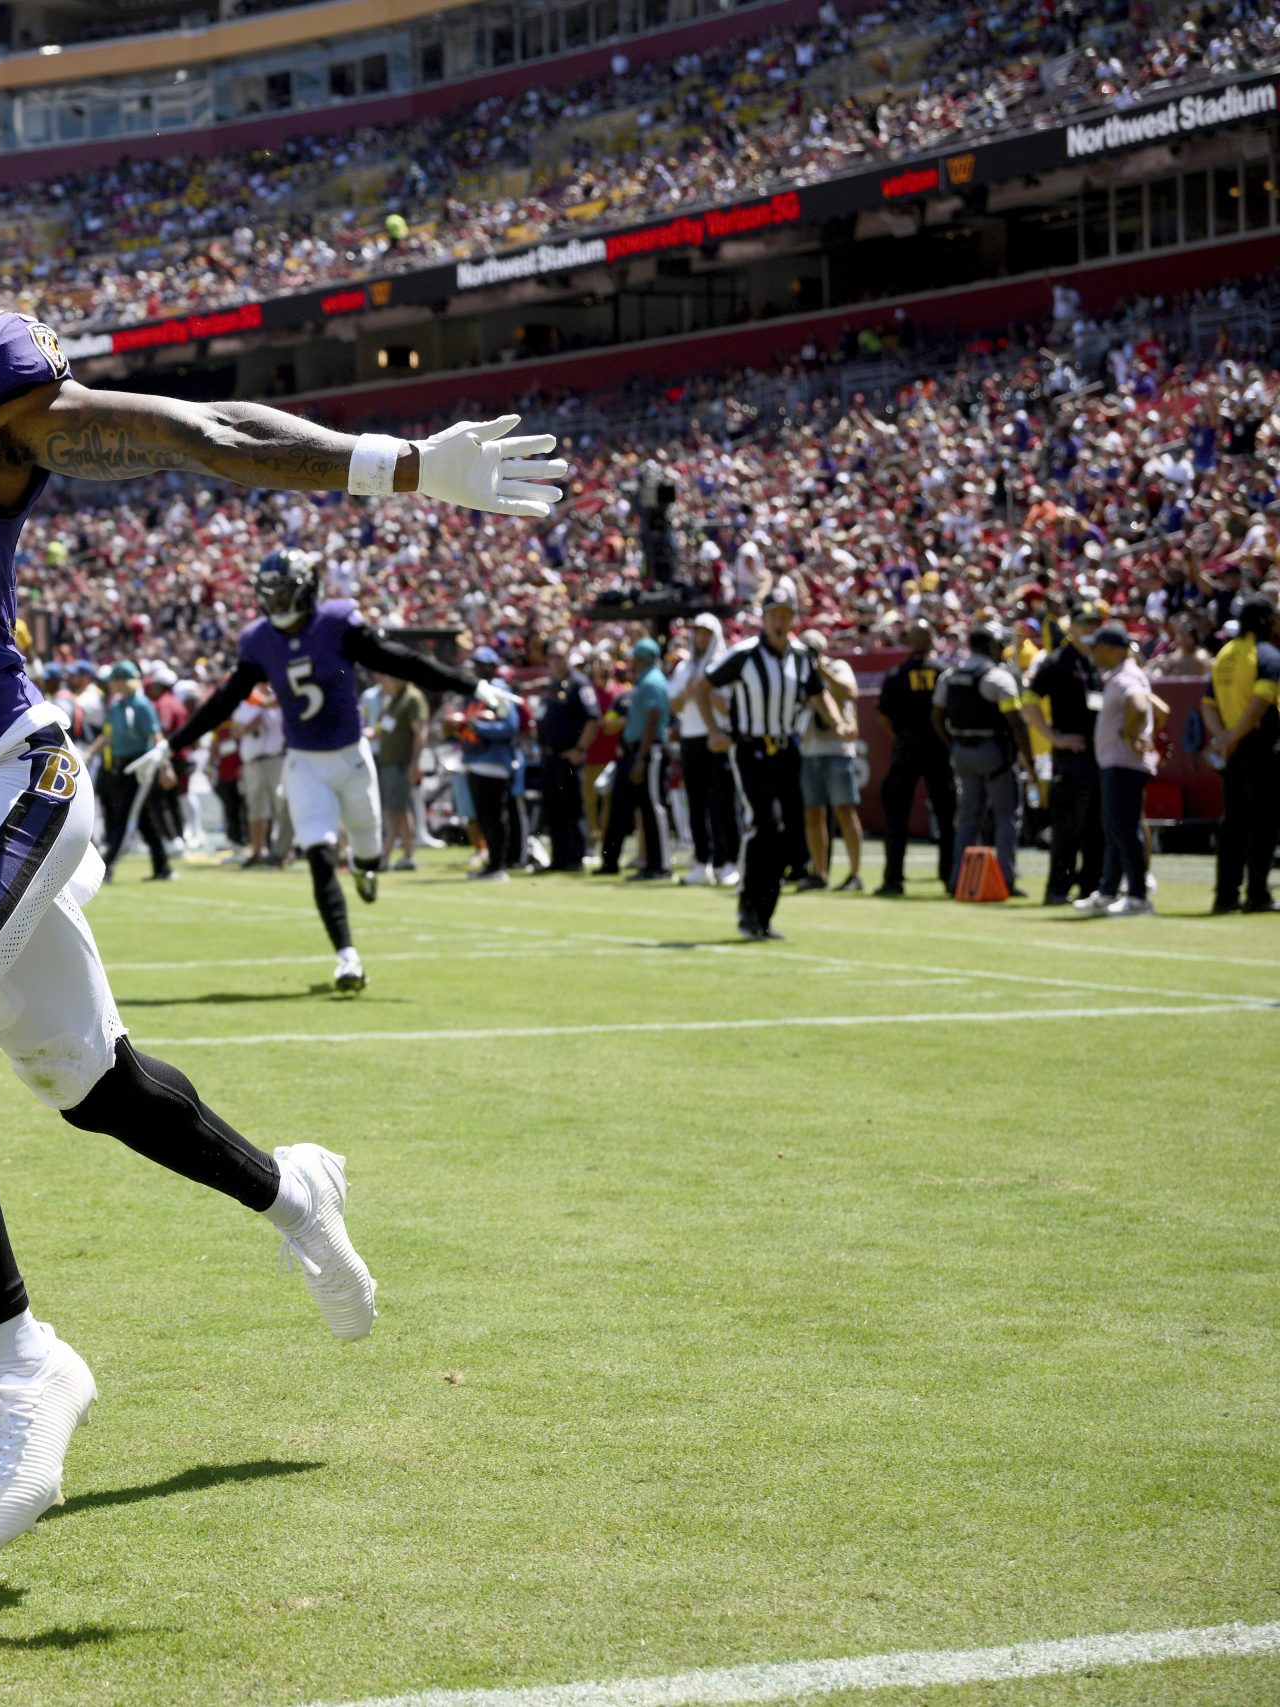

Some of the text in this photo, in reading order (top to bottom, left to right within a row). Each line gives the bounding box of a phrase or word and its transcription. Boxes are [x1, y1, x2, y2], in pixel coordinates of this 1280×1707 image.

[1067, 83, 1276, 157] Northwest Stadium
[457, 251, 538, 289] Northwest
[538, 238, 607, 272] Stadium
[286, 660, 324, 721] 5
[34, 746, 80, 801] B
